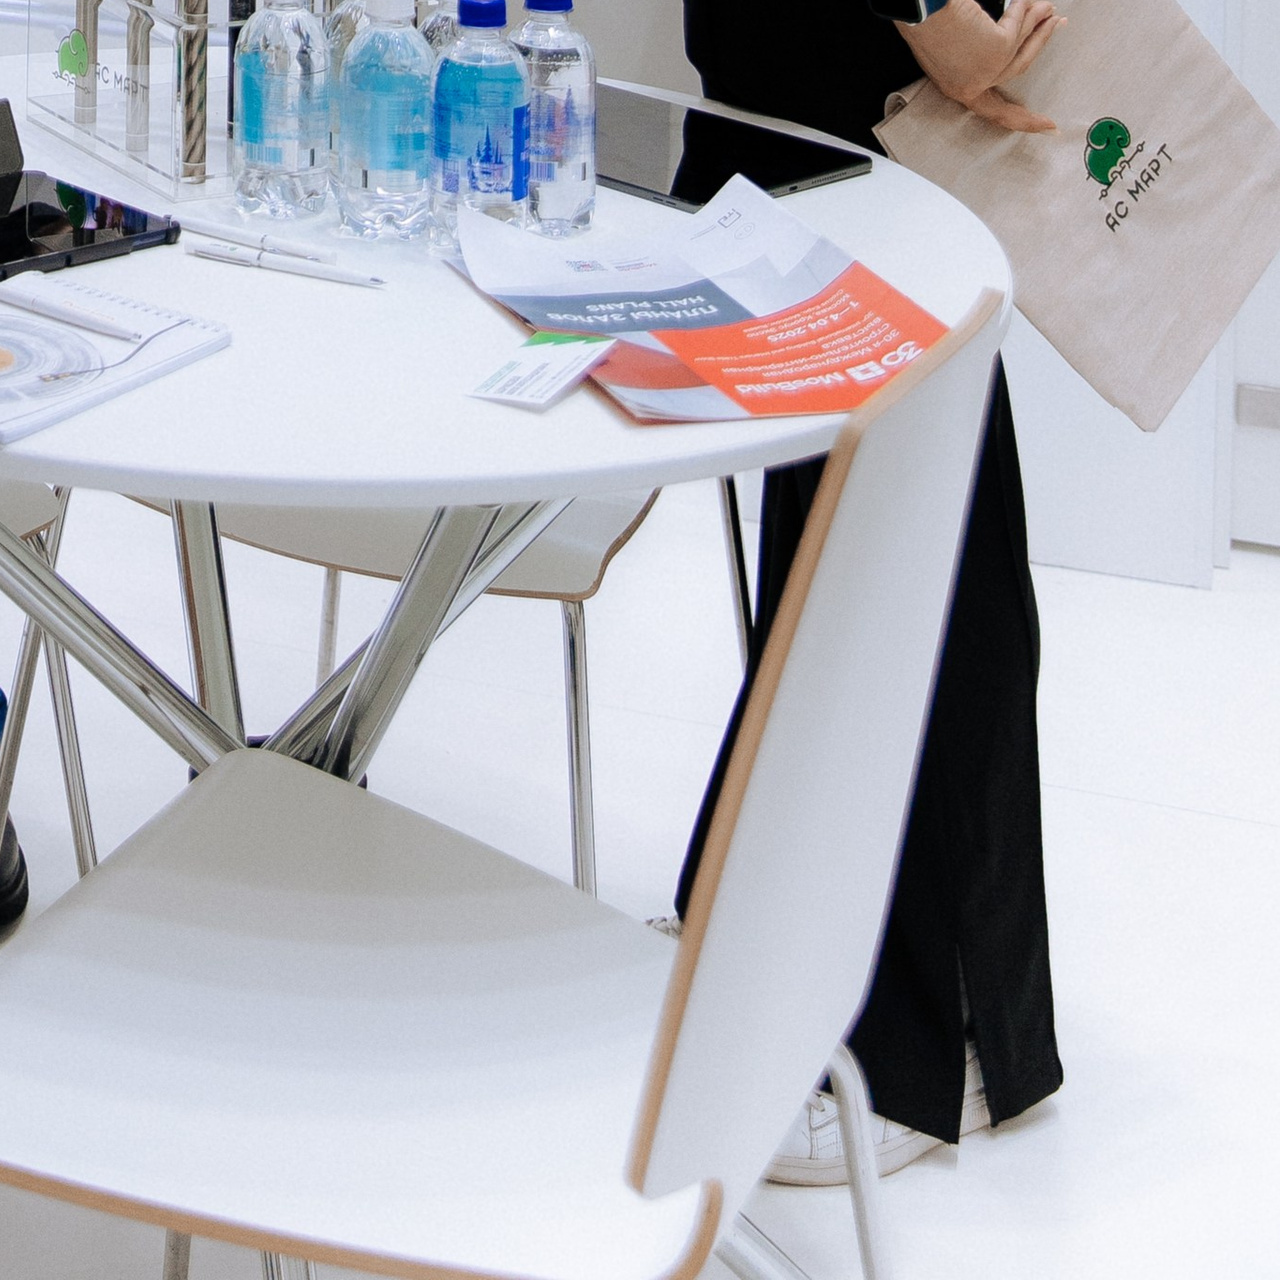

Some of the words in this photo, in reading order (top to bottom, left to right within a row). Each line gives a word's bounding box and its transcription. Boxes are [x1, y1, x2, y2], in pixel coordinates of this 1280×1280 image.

[114, 70, 149, 103] МАРТ
[1105, 200, 1130, 233] АС
[1127, 143, 1173, 203] МАРТ
[585, 300, 652, 312] PLANS
[630, 304, 718, 321] ПЛАНЫ
[653, 295, 707, 308] HALL
[546, 312, 627, 323] ЗАЛОВ
[821, 316, 881, 350] выставка
[872, 328, 900, 349] 30-я
[722, 323, 889, 374] строительно-интерьерная
[881, 340, 924, 367] 30
[762, 346, 872, 378] Международная
[734, 371, 845, 395] MosBuild
